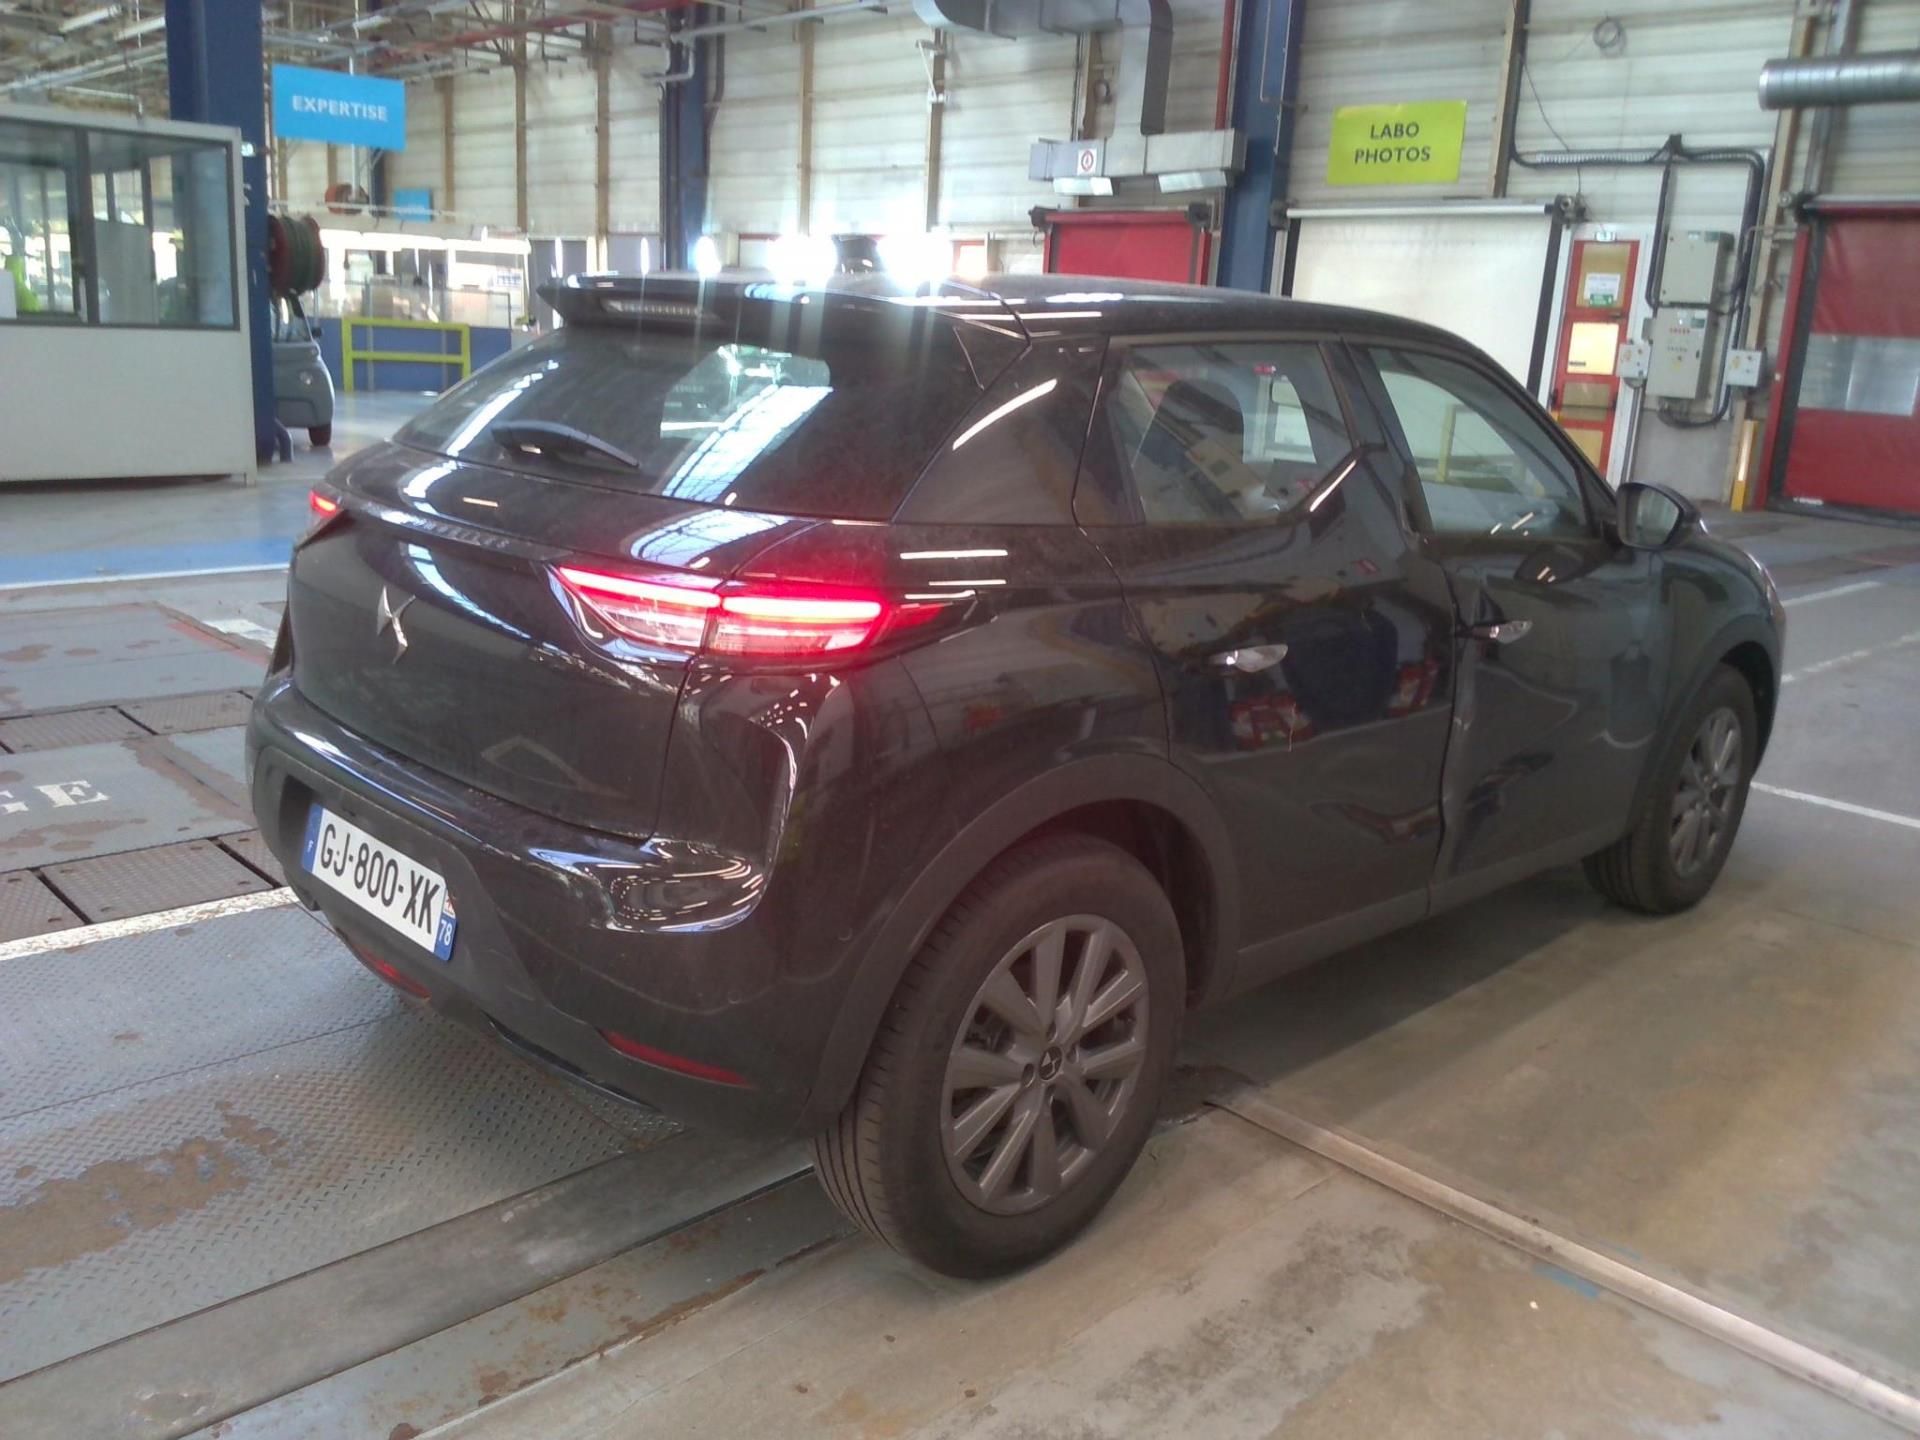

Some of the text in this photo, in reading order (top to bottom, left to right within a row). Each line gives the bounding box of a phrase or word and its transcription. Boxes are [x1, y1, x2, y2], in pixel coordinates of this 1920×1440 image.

[292, 95, 388, 122] EXPERTISE
[1370, 121, 1420, 139] LABO
[1354, 146, 1431, 164] PHOTOS
[320, 823, 440, 935] GJ-800-XK
[438, 919, 453, 946] 78
